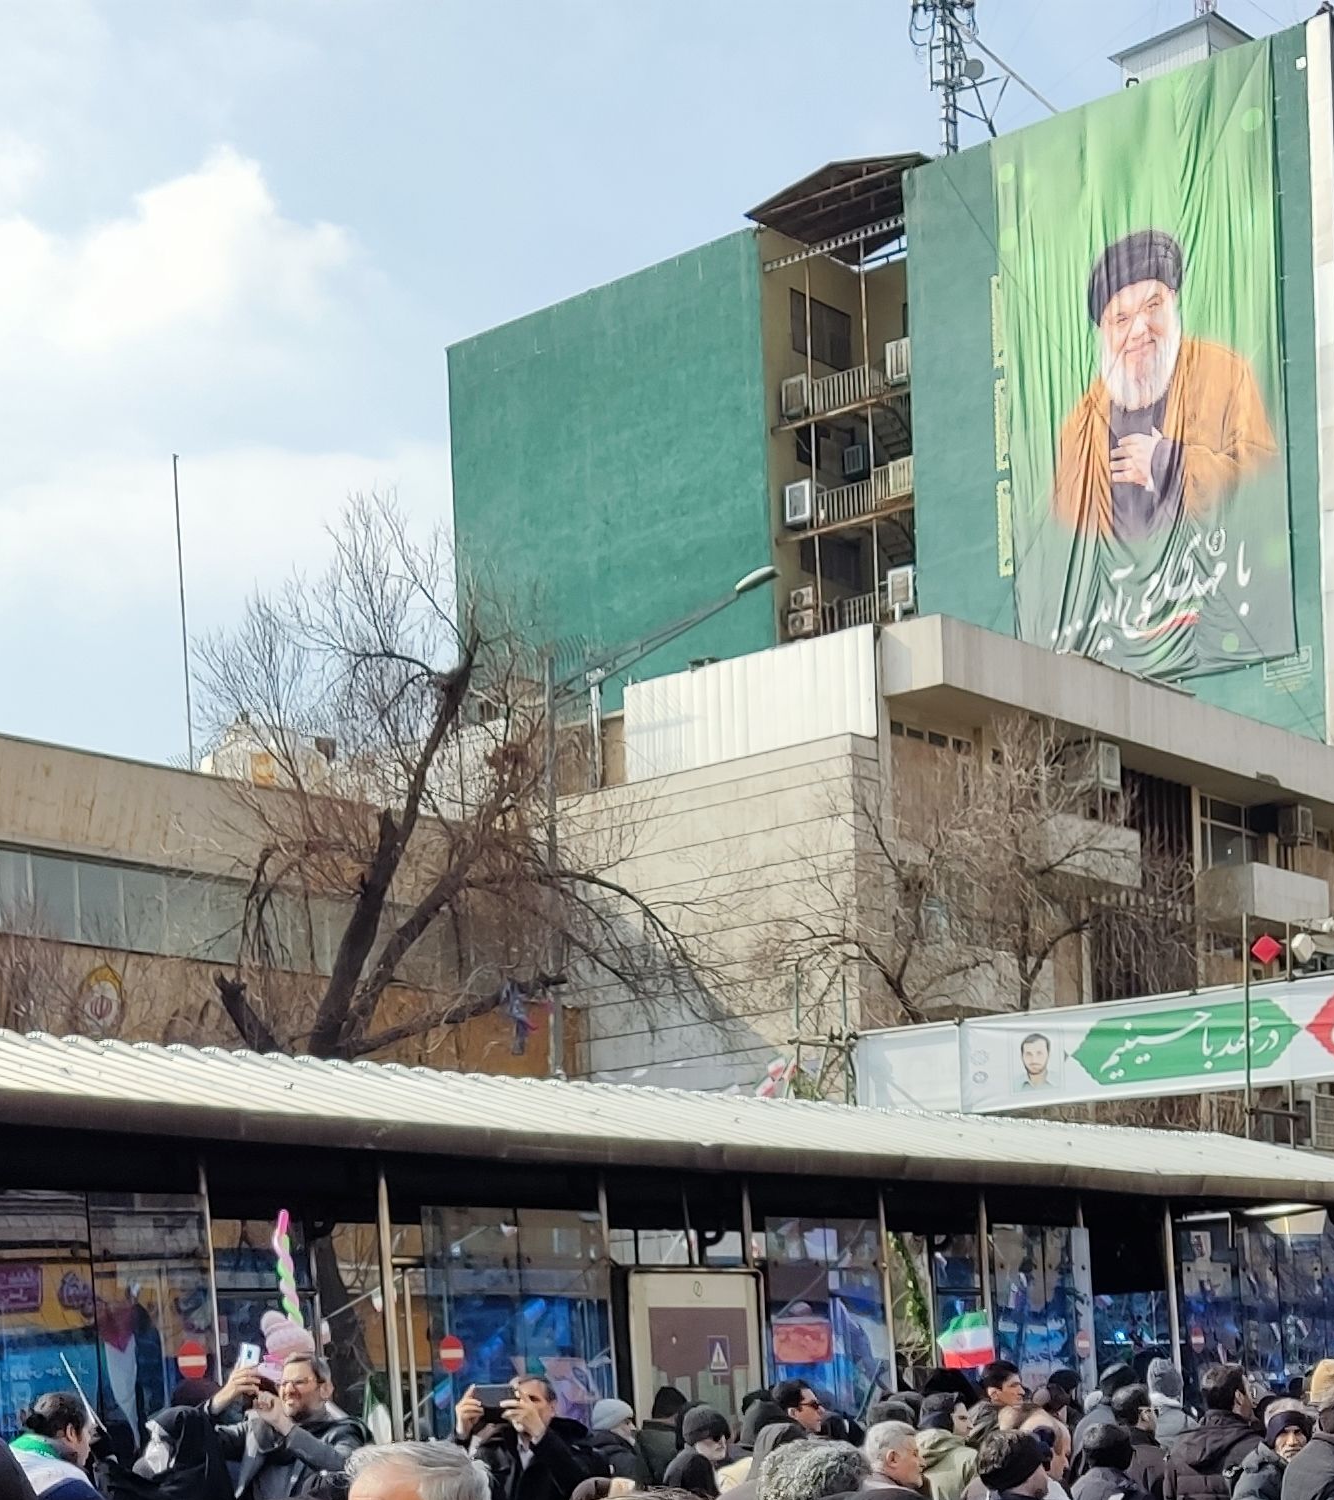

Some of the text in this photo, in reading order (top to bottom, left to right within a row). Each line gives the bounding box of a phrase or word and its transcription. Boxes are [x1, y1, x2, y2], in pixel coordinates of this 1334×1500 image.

[1100, 1011, 1280, 1081] در عهد با حسینیم
